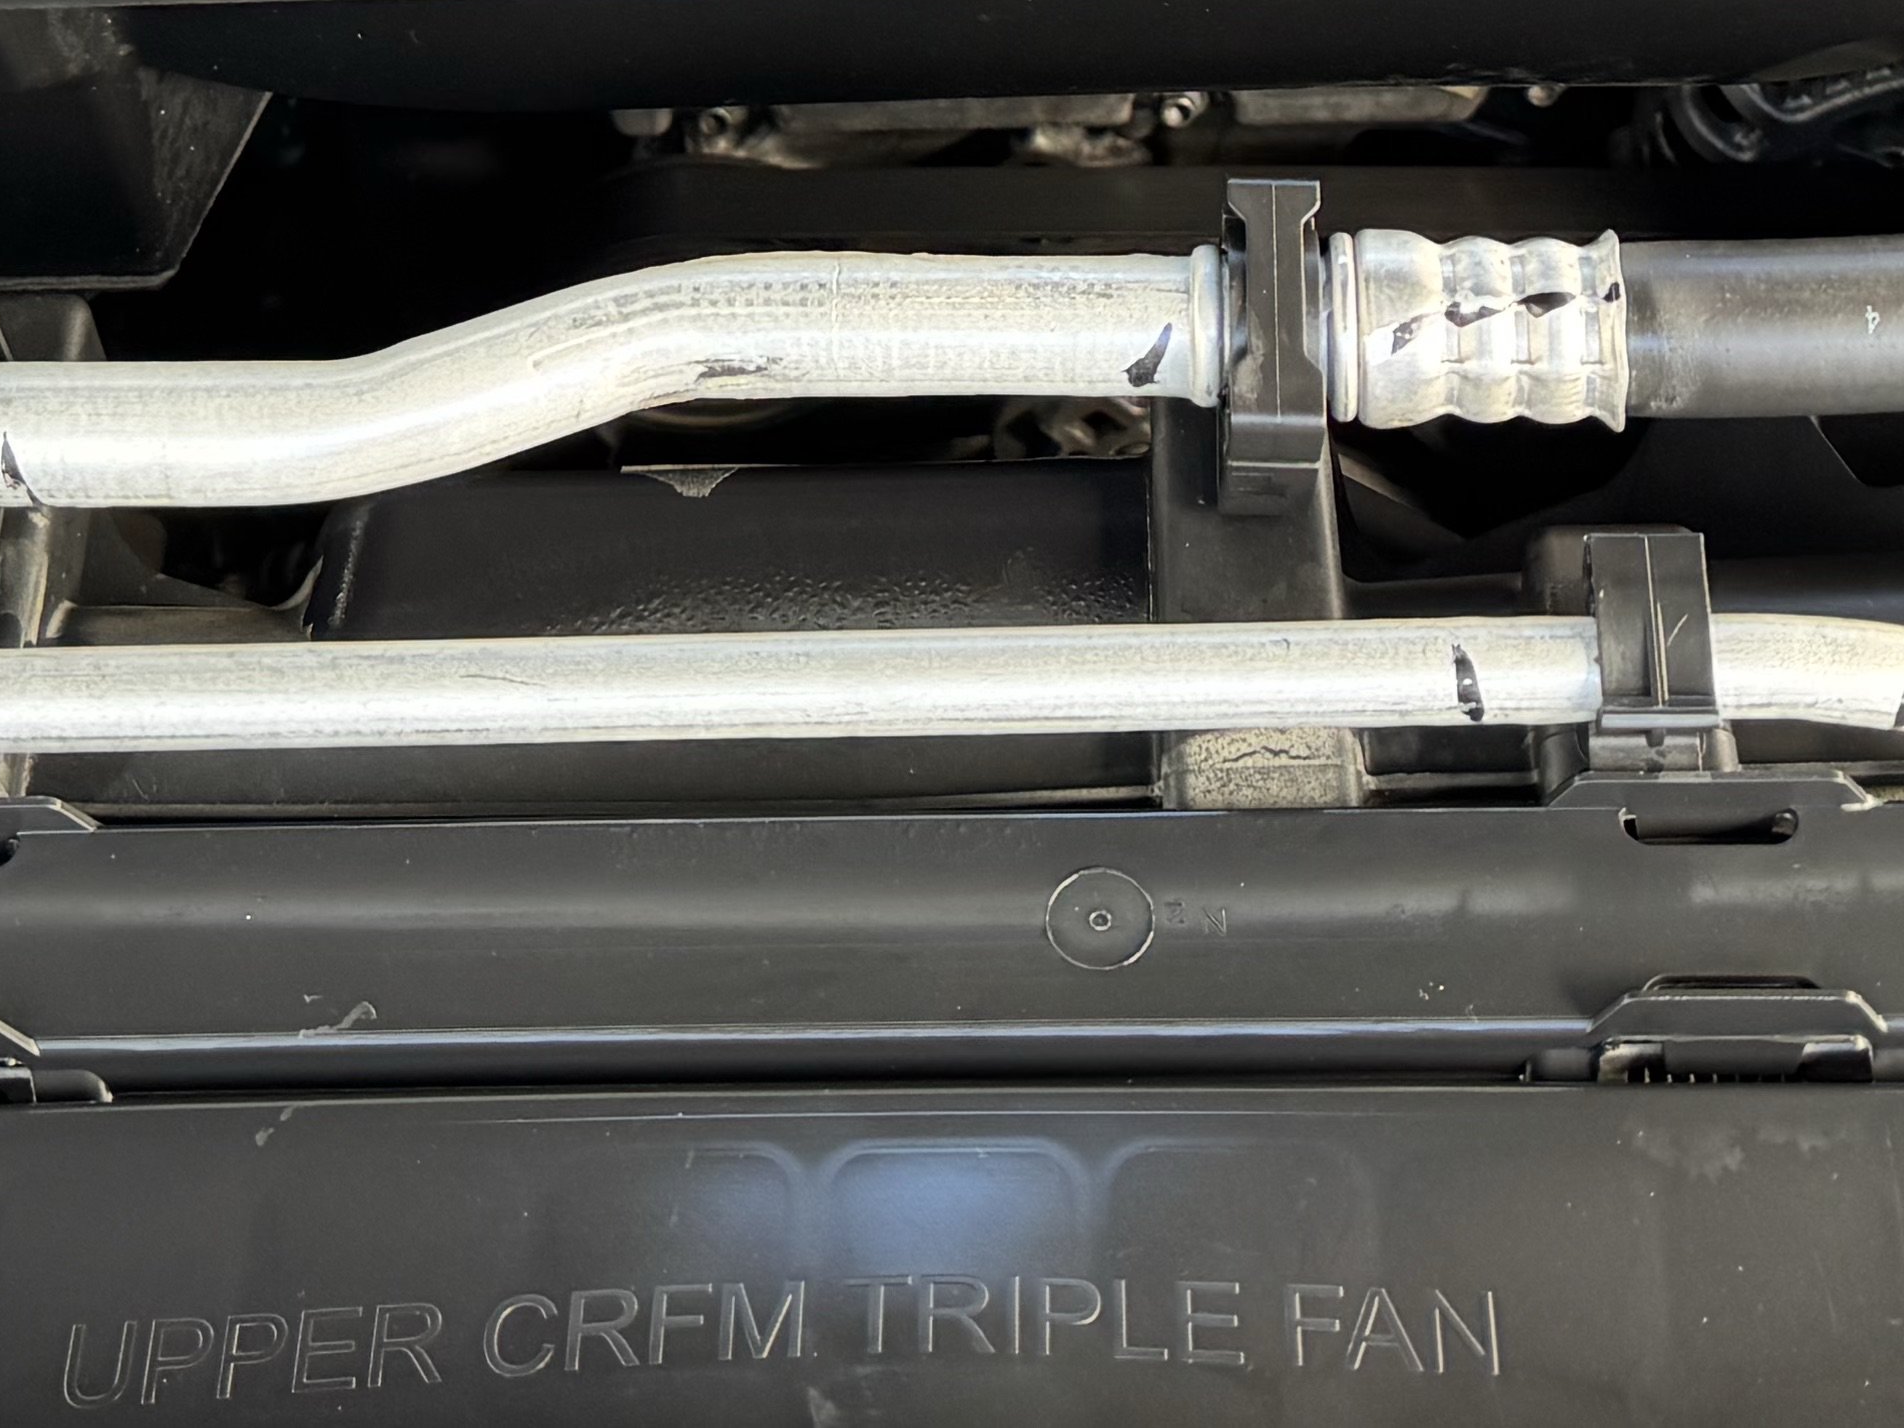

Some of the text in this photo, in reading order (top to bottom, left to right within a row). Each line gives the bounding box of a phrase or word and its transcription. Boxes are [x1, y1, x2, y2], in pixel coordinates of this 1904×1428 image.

[59, 1273, 1501, 1411] UPPER CRFM TRIPLE FAN
